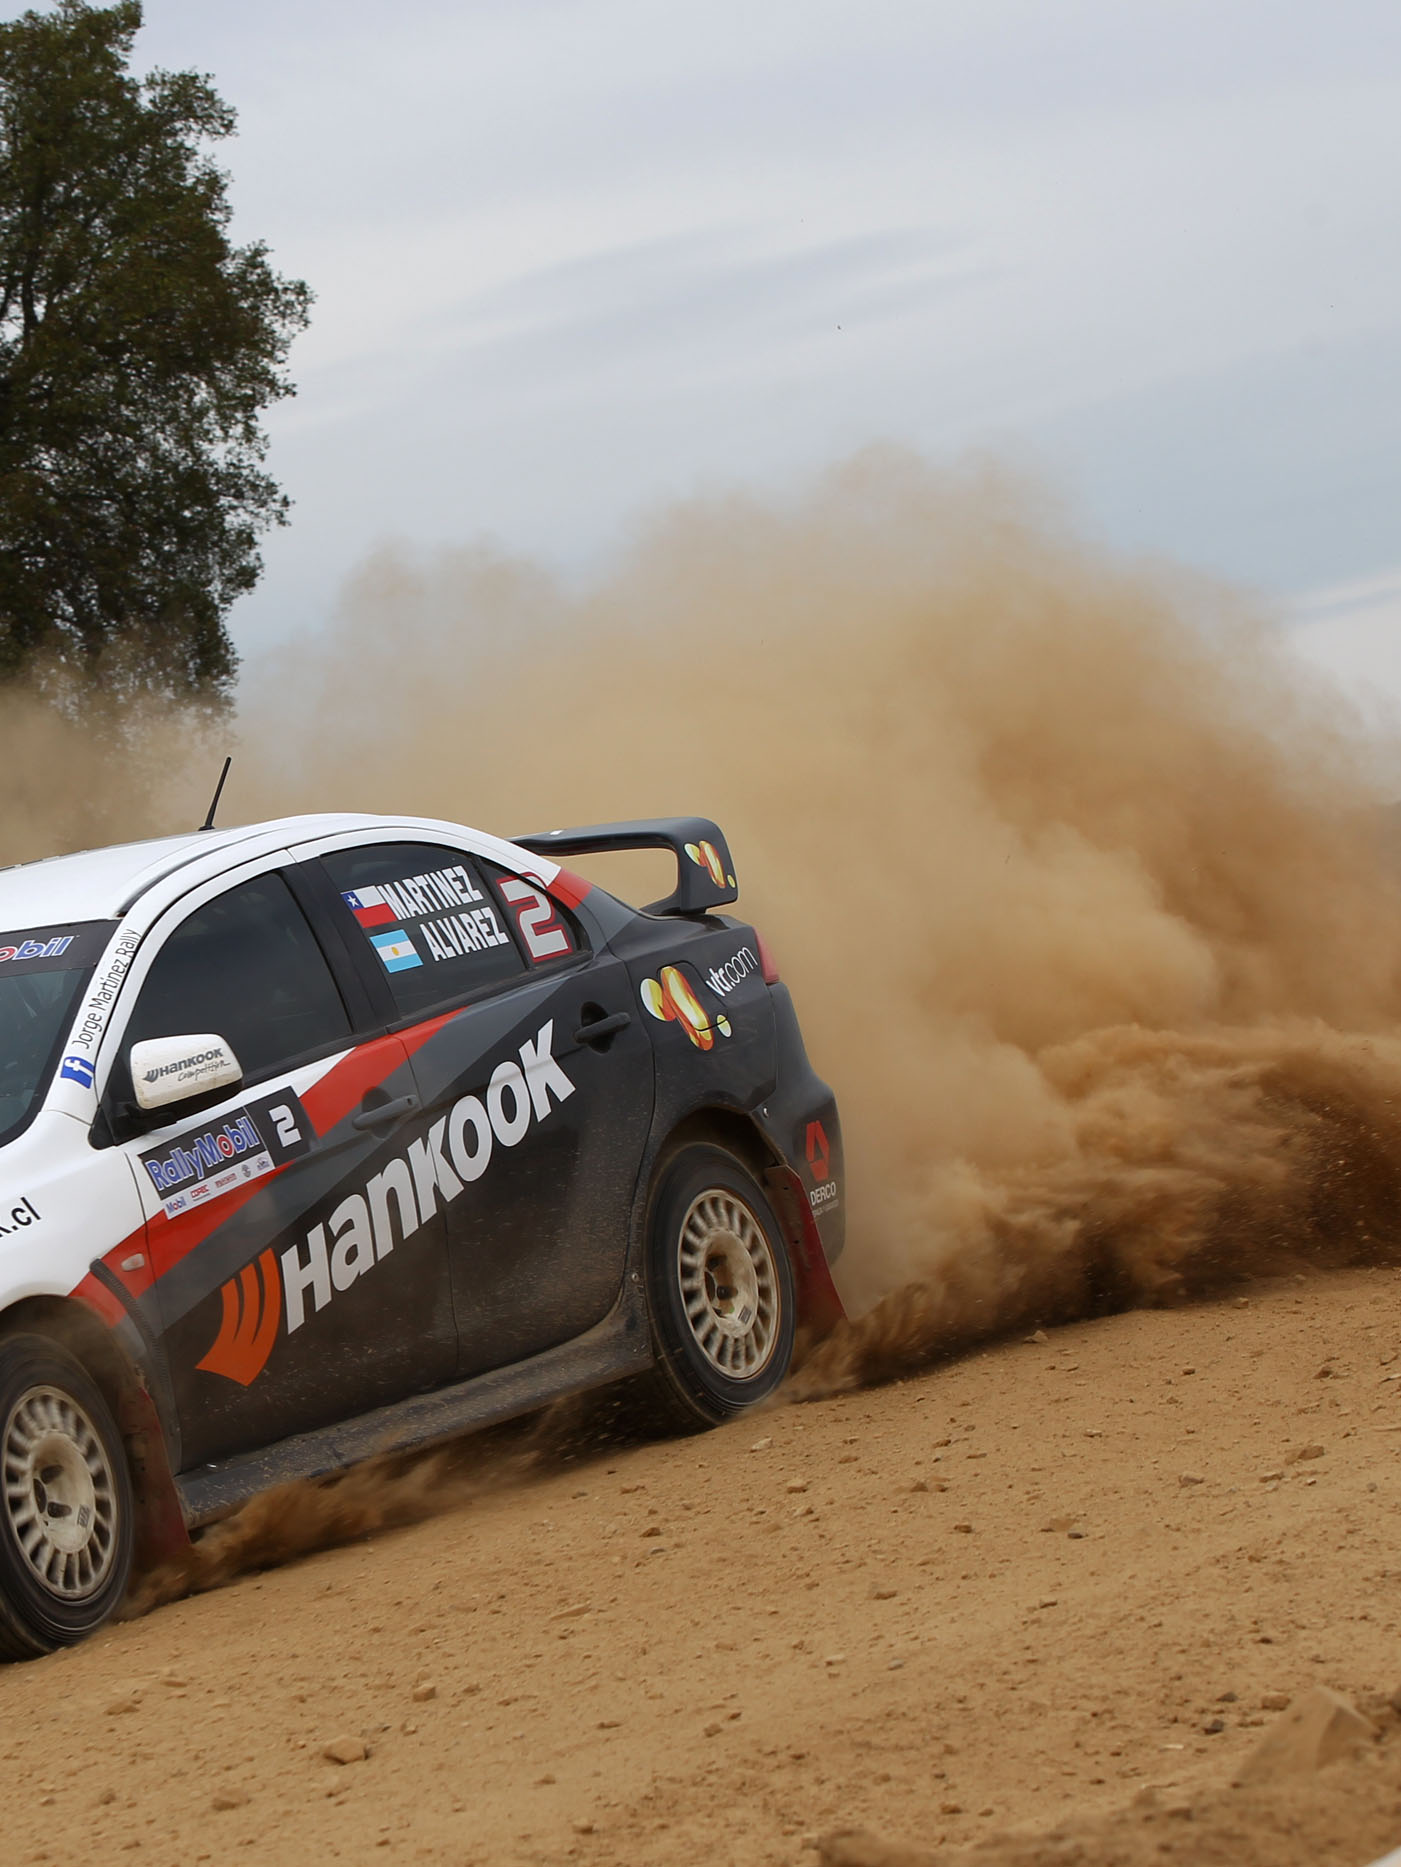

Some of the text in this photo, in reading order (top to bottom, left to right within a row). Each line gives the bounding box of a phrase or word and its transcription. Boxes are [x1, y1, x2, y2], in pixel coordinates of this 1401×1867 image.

[376, 865, 484, 921] MARTINEZ
[496, 871, 572, 963] 2
[419, 907, 510, 961] ALVAREZ
[71, 1012, 103, 1050] Jorge
[115, 928, 143, 960] Rally
[705, 946, 759, 997] vtr.com
[144, 1116, 261, 1191] RallyMobil
[268, 1104, 302, 1148] 2
[809, 1181, 837, 1206] DERCO
